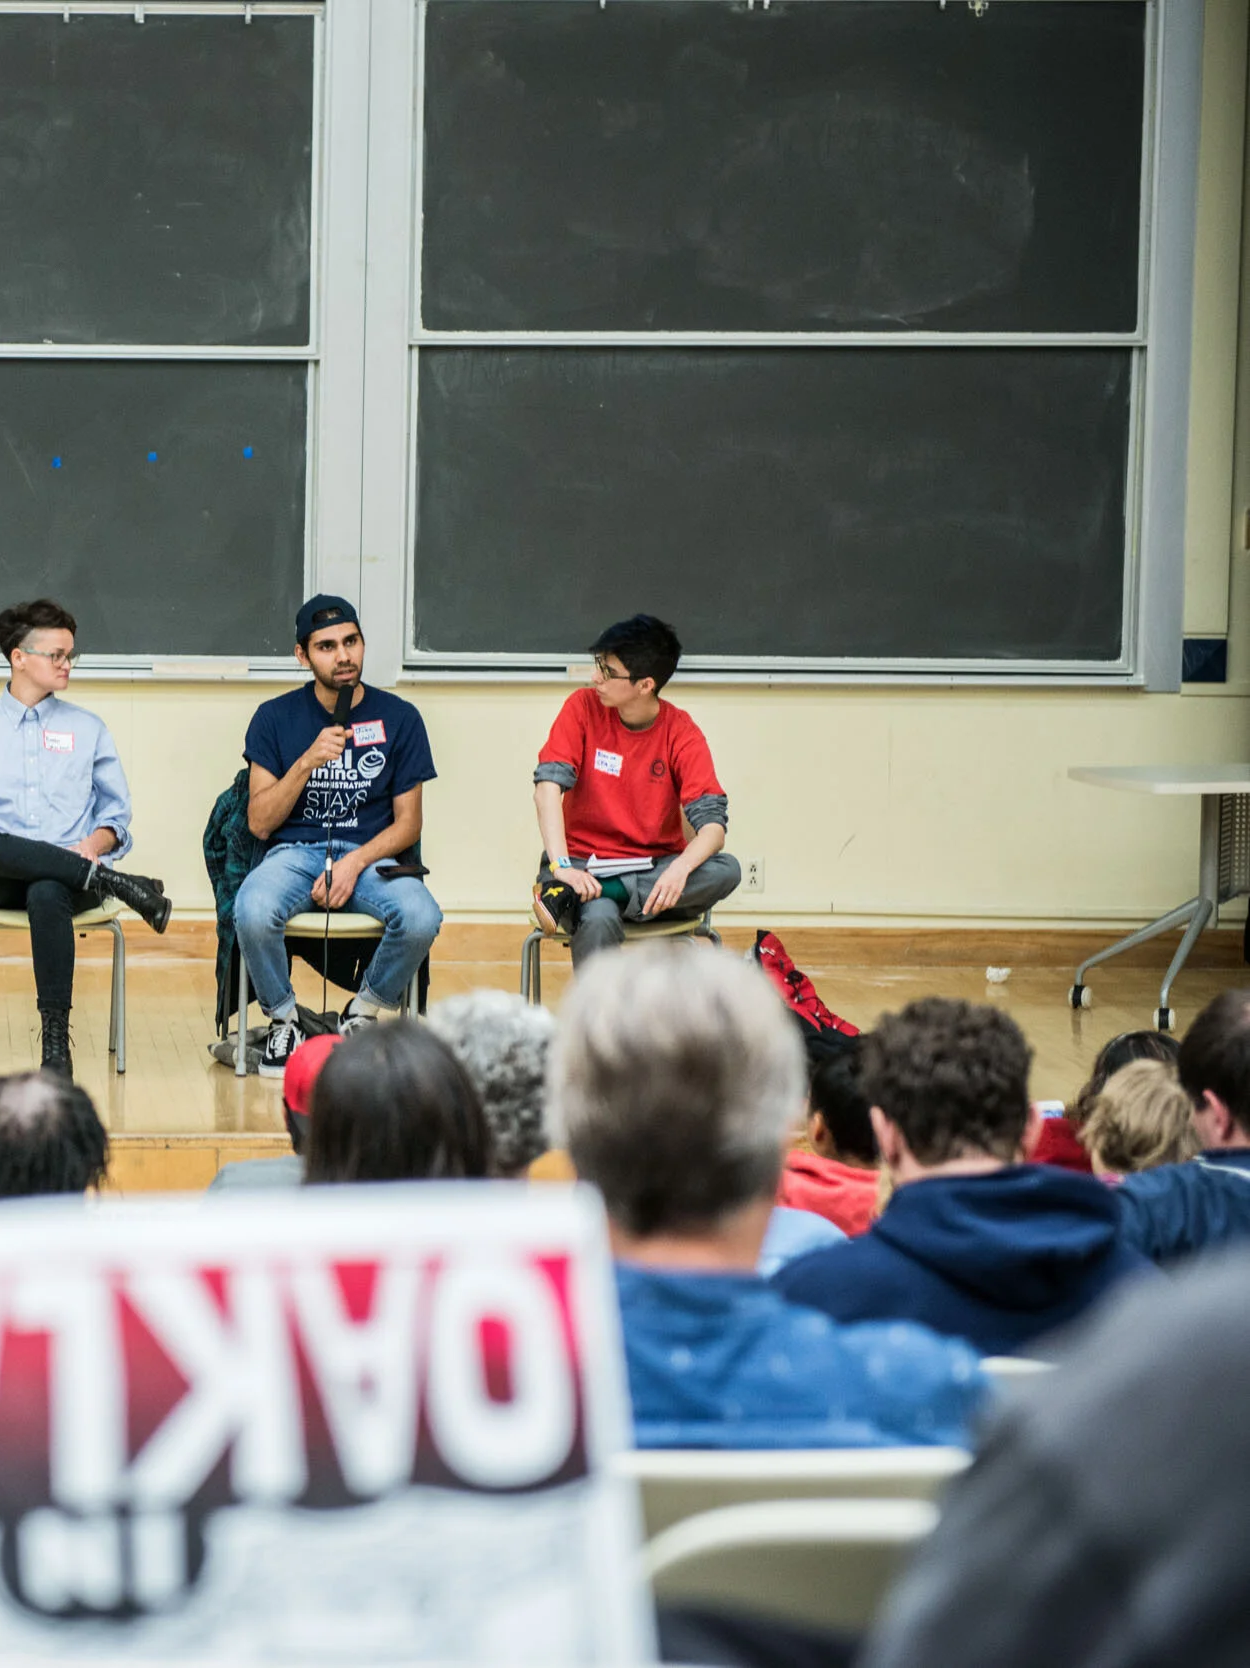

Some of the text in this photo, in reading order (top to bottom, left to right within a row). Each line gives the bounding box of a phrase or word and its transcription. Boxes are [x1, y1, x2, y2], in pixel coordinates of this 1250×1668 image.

[311, 768, 358, 780] ining
[306, 780, 372, 789] ADMINISTRATION
[307, 790, 368, 808] STAYS
